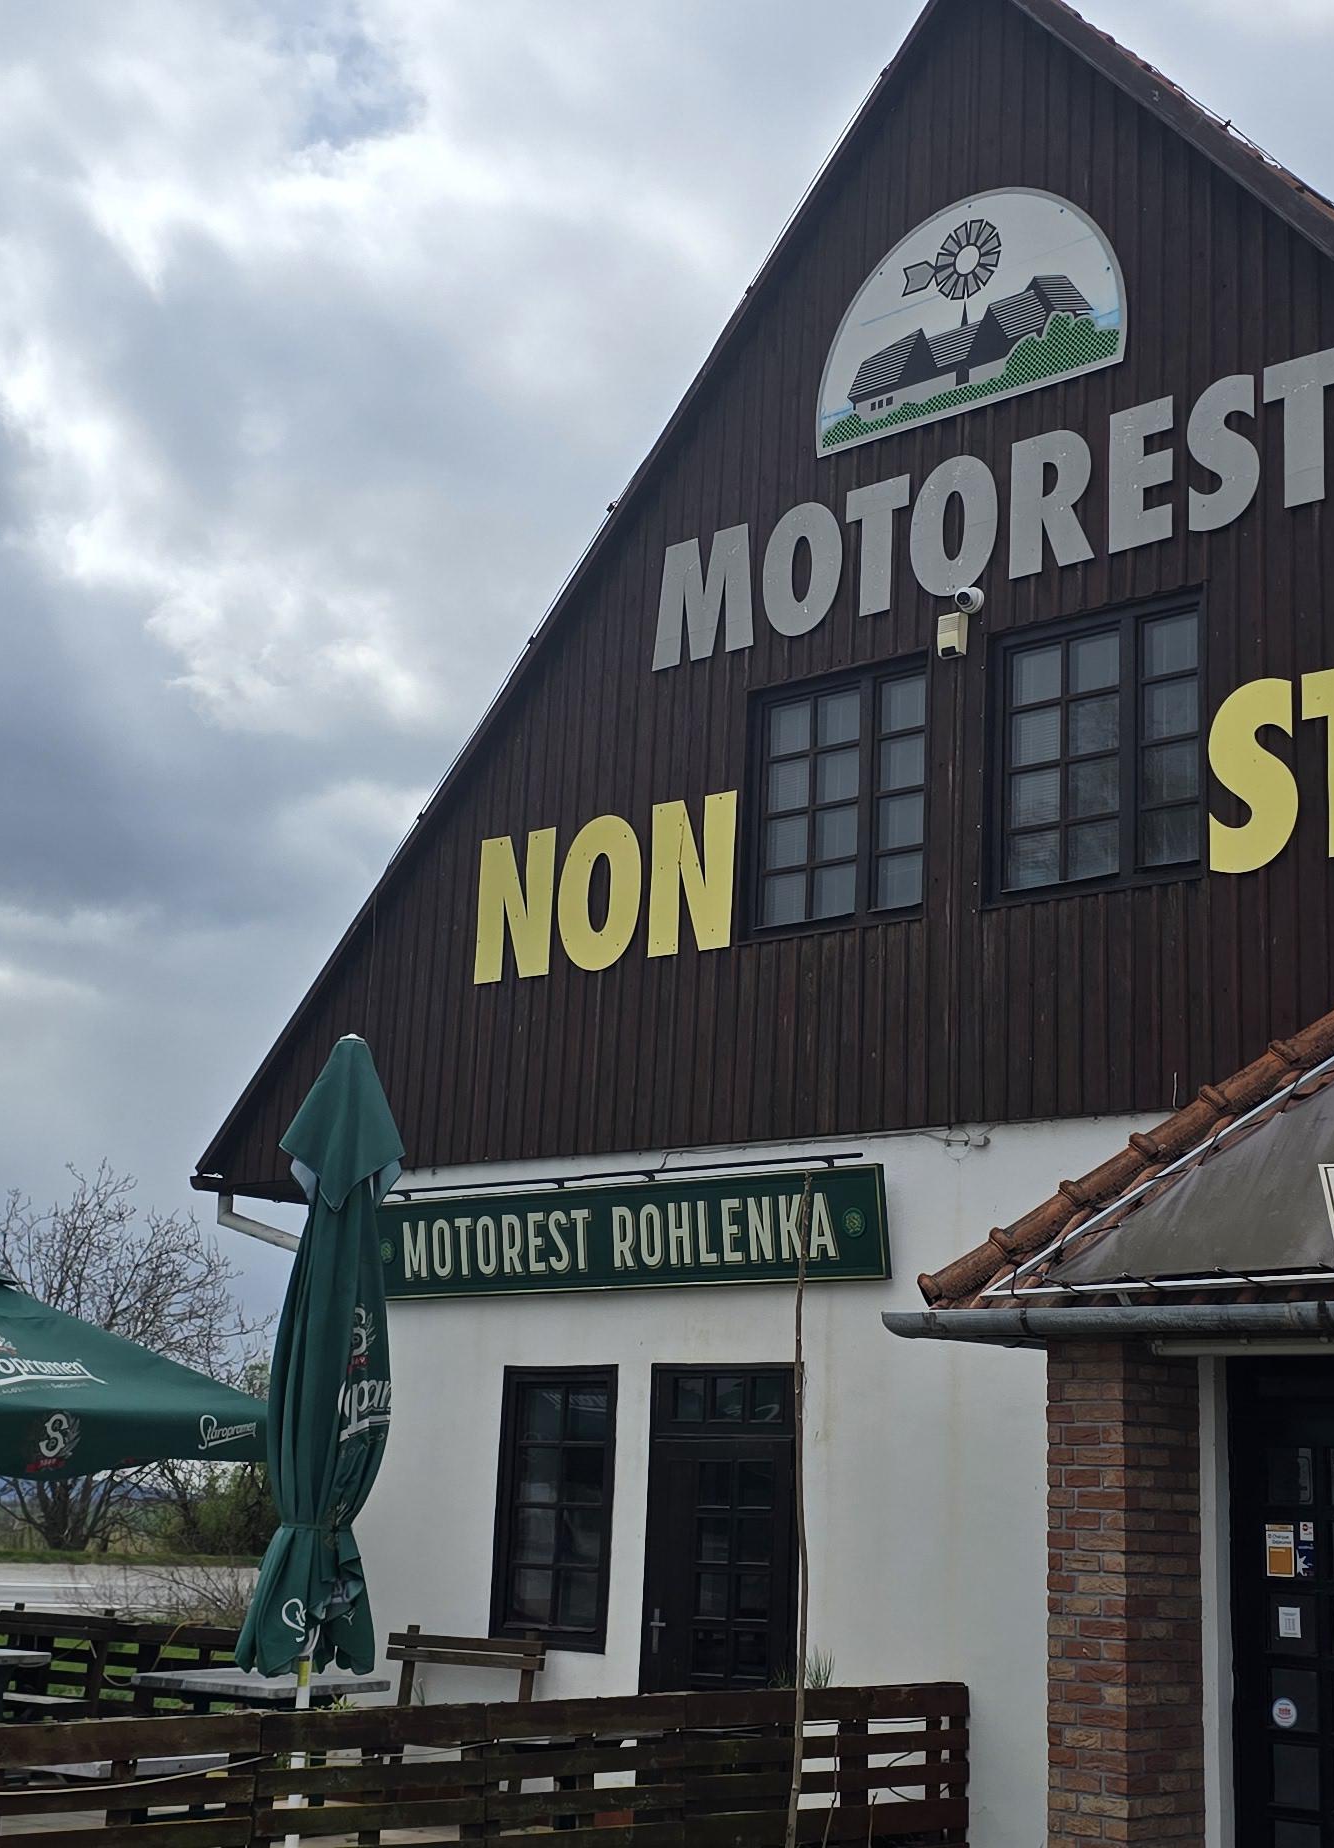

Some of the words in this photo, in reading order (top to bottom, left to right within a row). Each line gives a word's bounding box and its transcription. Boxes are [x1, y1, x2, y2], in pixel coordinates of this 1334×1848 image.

[473, 789, 738, 986] NON
[402, 1208, 591, 1281] MOTOREST
[611, 1192, 840, 1270] ROHLENKA
